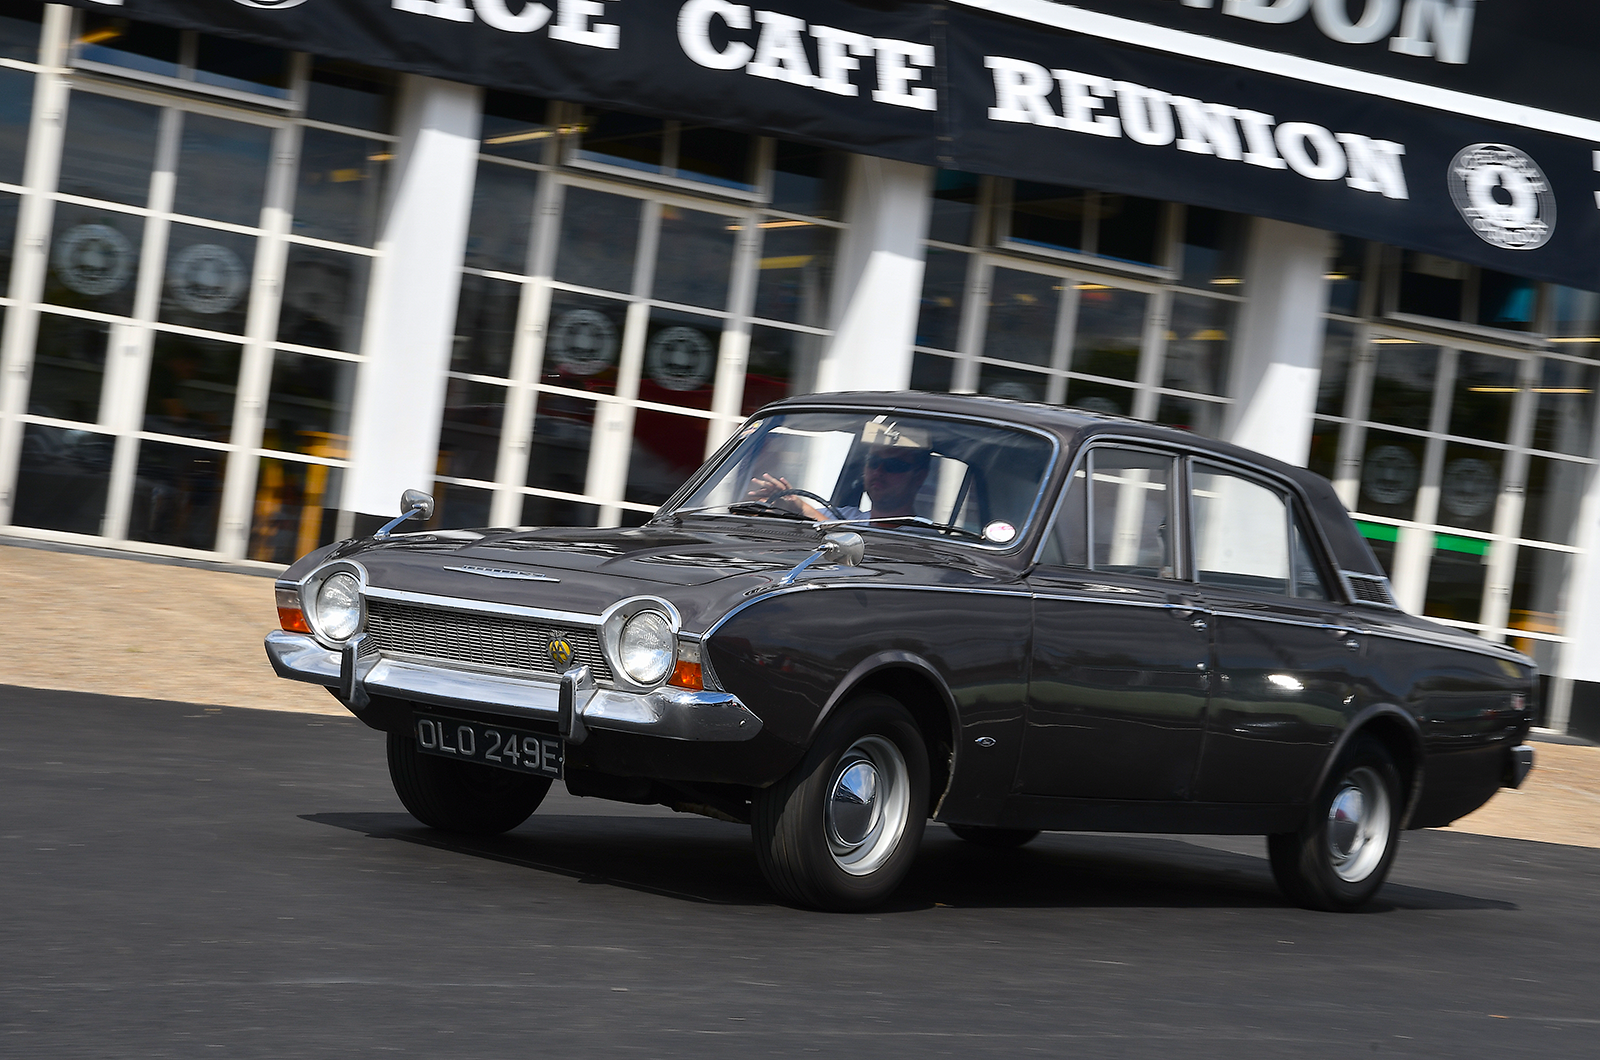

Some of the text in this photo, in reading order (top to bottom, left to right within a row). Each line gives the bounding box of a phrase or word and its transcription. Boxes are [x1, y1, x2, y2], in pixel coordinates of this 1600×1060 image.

[676, 0, 937, 111] CAFE
[983, 55, 1409, 200] REUNION
[418, 719, 559, 774] OLO 249E
